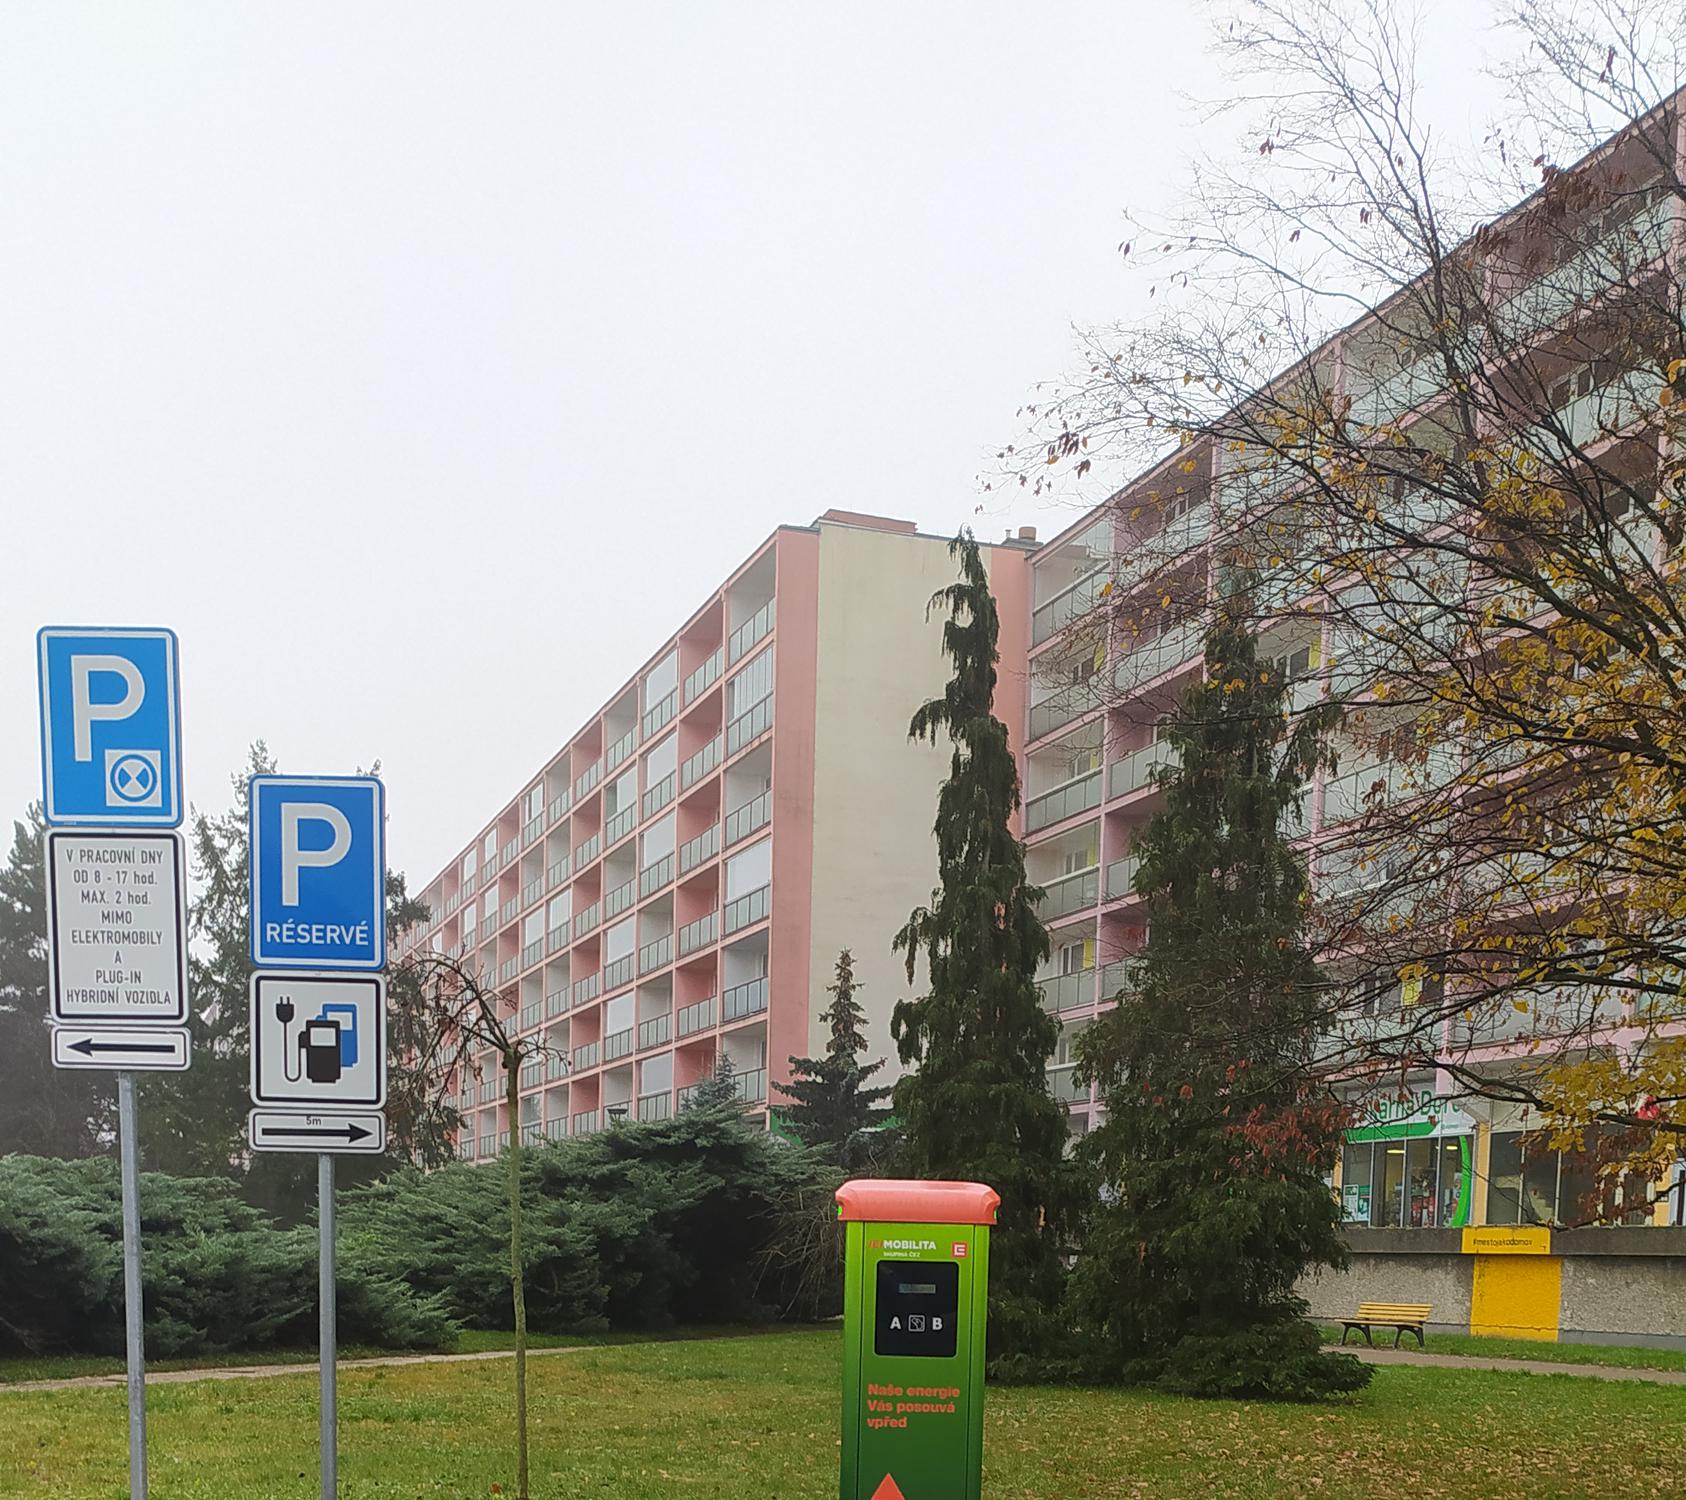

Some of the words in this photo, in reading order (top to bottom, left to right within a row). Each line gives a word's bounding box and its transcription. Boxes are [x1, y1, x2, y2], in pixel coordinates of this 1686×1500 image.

[71, 655, 146, 762] P
[66, 849, 74, 862] V
[80, 847, 135, 864] PRACOVNÍ
[141, 850, 163, 864] DNY
[281, 802, 352, 906] P
[73, 869, 88, 883] OD
[94, 870, 101, 883] 8
[116, 871, 128, 884] 17
[133, 871, 157, 885] hod.
[81, 890, 109, 904] MAX.
[115, 890, 122, 904] 2
[127, 891, 151, 905] hod.
[101, 911, 132, 925] MIMO
[71, 930, 162, 945] ELEKTROMOBILY
[266, 918, 368, 945] RÉSERVÉ
[114, 950, 122, 964] A
[95, 969, 142, 984] PLUG-IN
[66, 986, 119, 1003] HYBRIDNÍ
[125, 990, 171, 1005] VOZIDLA
[306, 1115, 322, 1126] 5m
[890, 1316, 902, 1330] A
[932, 1317, 943, 1330] B
[868, 1384, 903, 1396] Naše
[906, 1386, 961, 1400] energie
[867, 1399, 893, 1412] Vás
[896, 1401, 956, 1414] posouvá
[867, 1416, 908, 1430] vpřed
